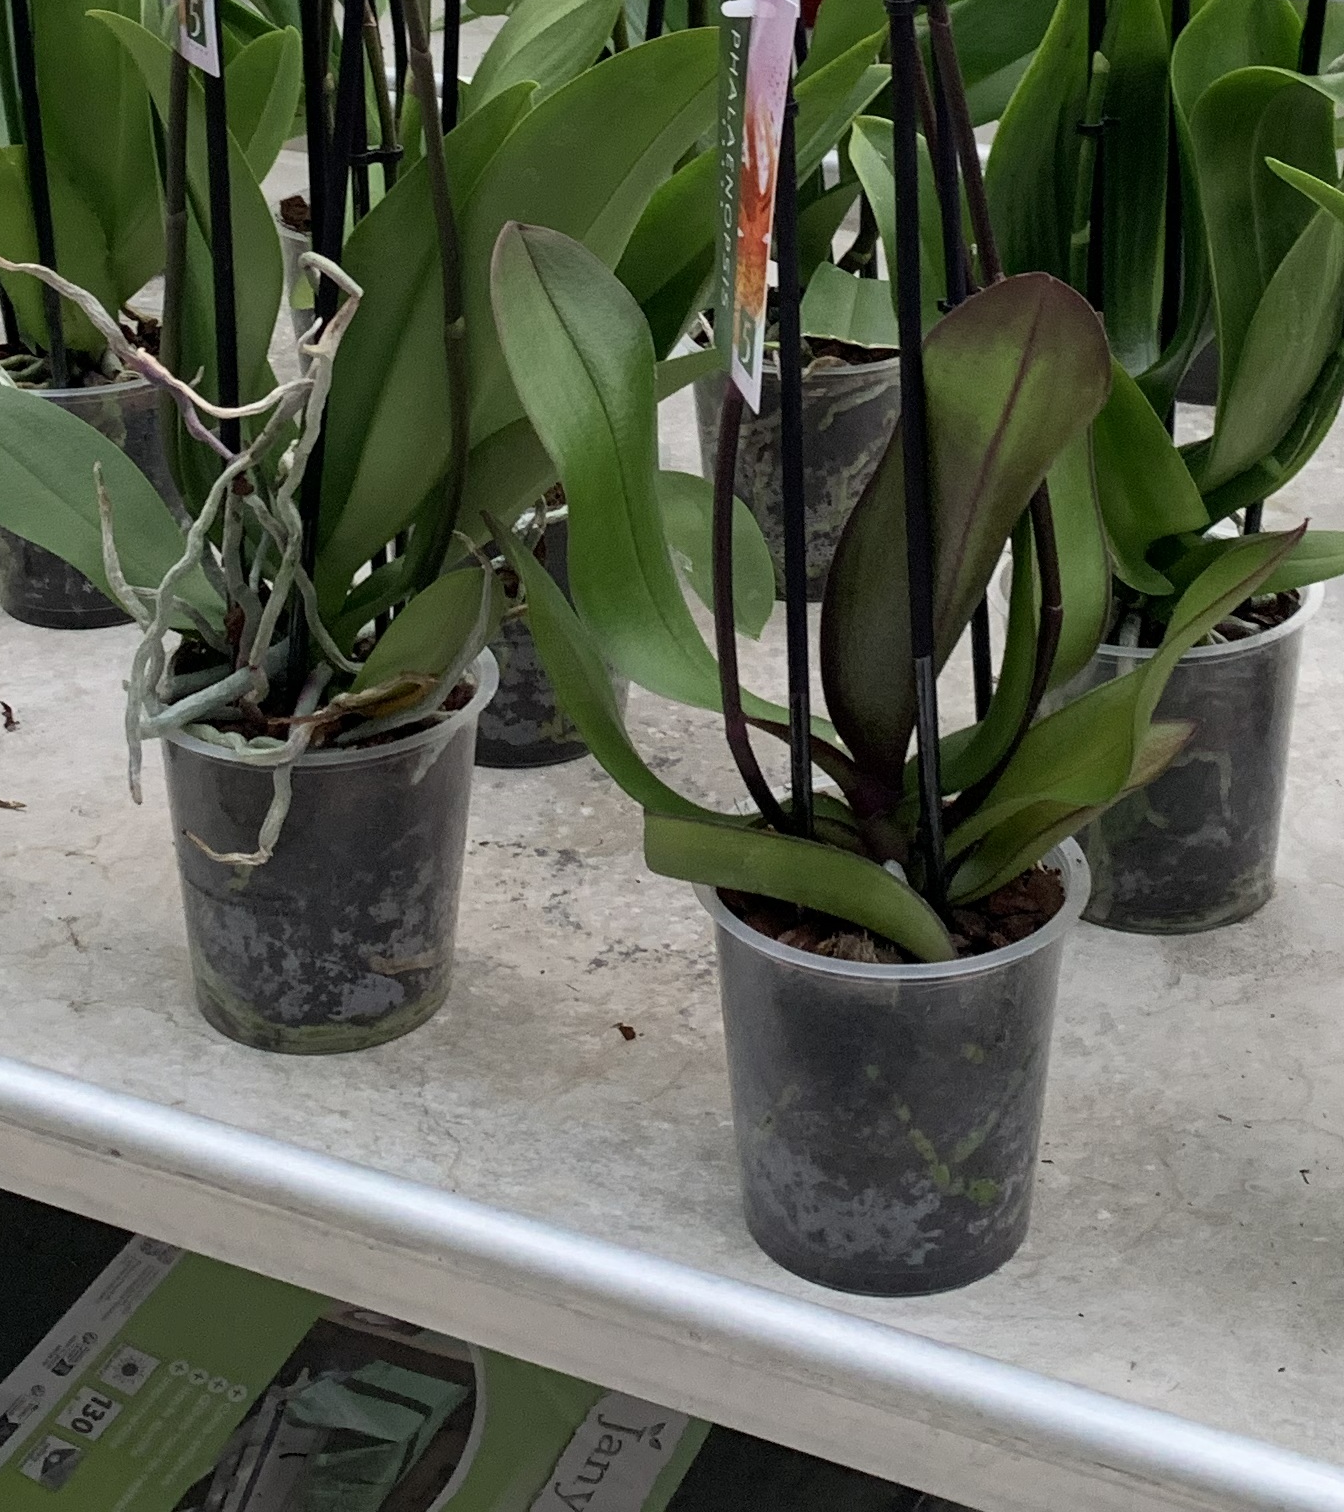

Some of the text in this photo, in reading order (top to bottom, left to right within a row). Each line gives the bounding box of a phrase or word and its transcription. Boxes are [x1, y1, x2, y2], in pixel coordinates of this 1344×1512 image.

[719, 28, 743, 309] PHALAENOPSIS
[737, 317, 754, 366] 5
[70, 1396, 115, 1436] 130
